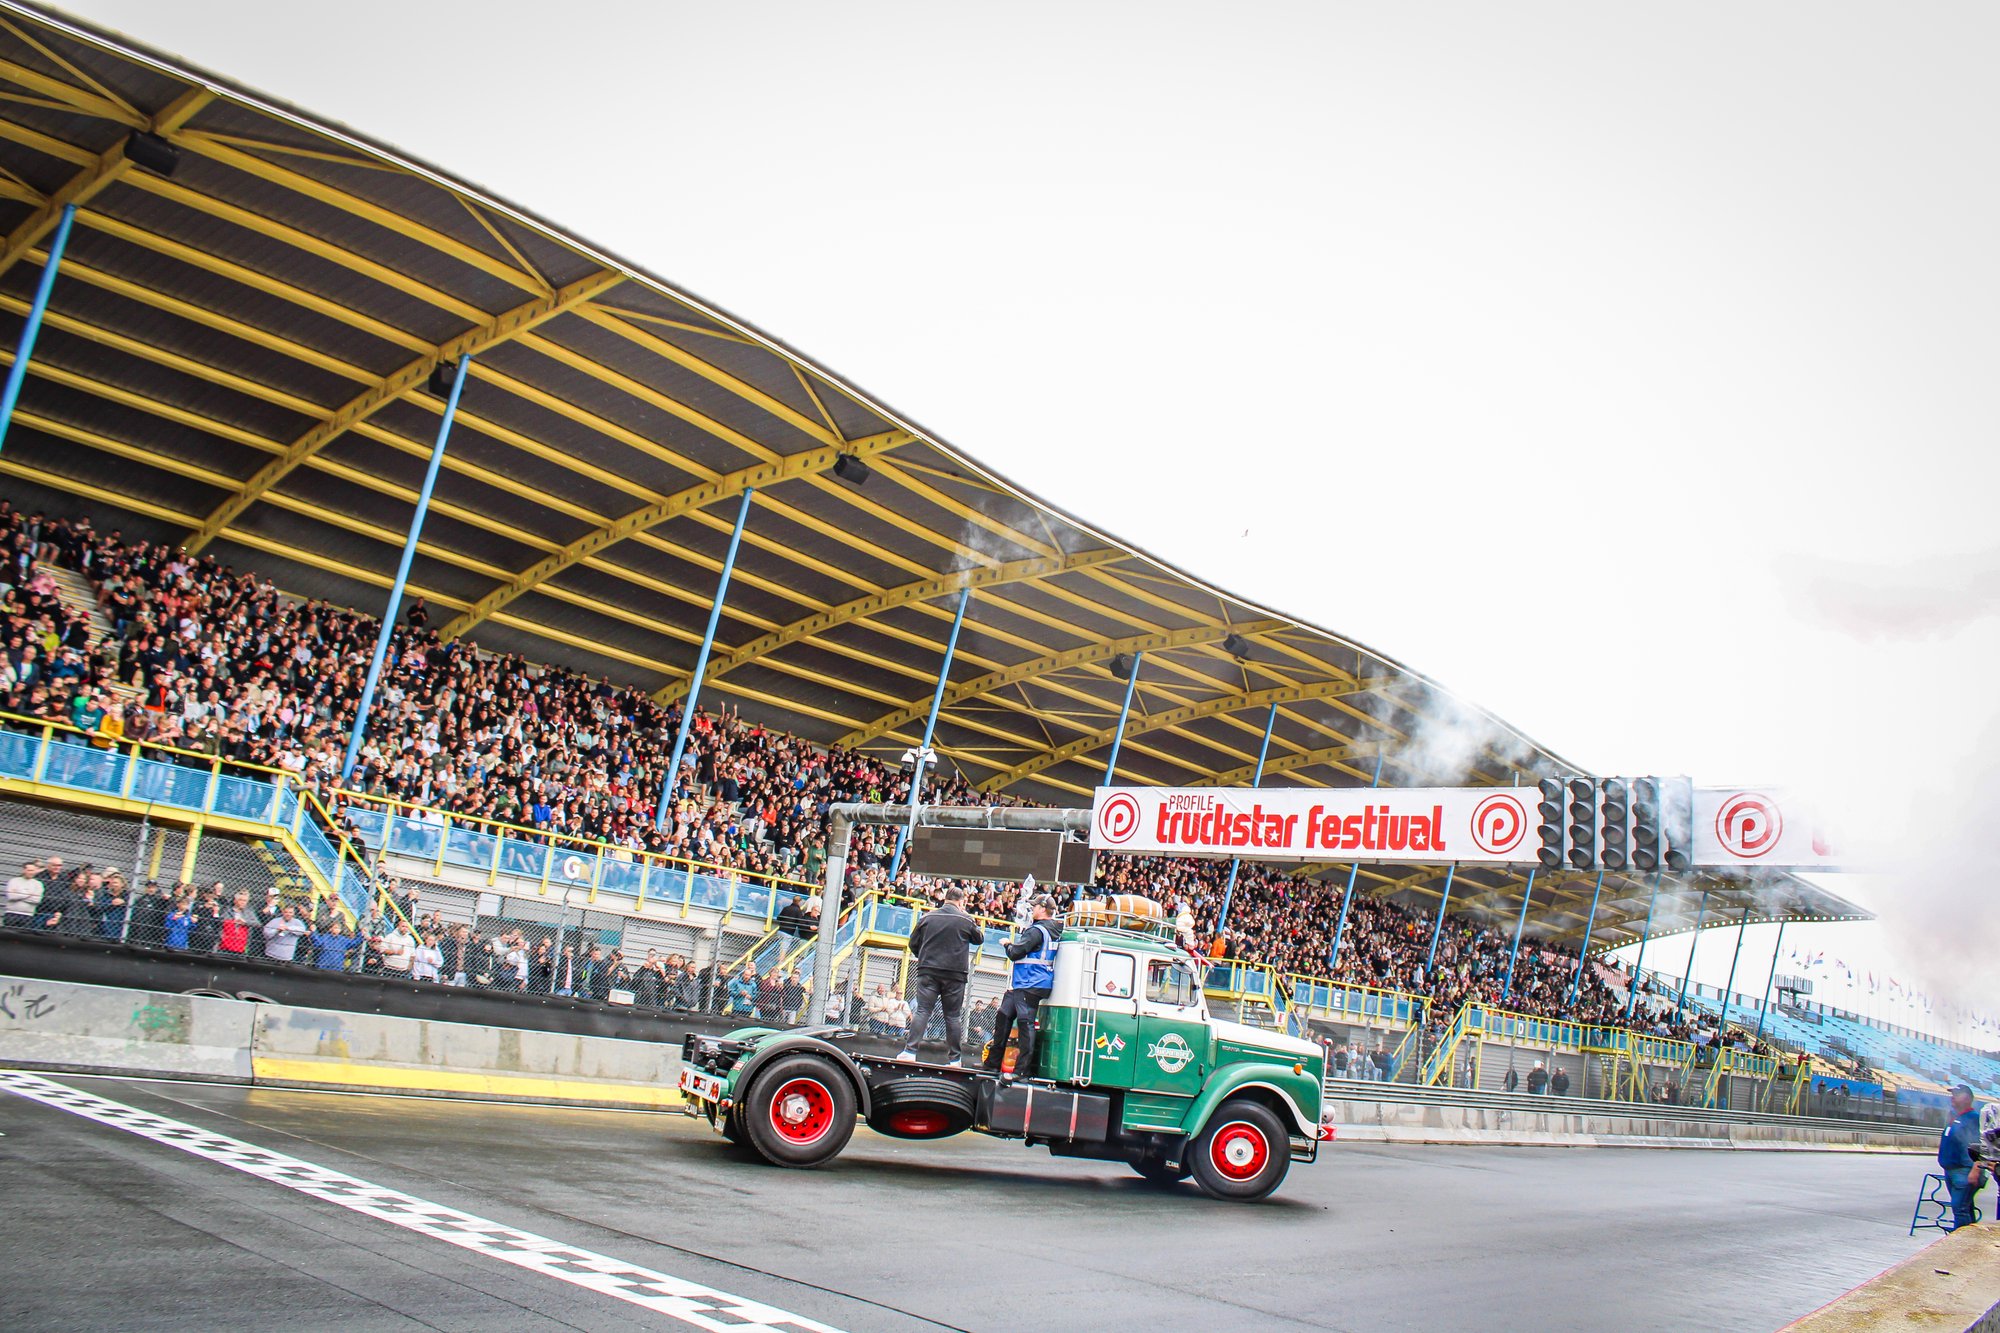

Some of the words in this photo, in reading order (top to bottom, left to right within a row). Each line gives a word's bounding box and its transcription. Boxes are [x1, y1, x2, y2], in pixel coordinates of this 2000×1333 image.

[1169, 795, 1214, 811] PROFILE
[1156, 803, 1299, 848] truckstar
[563, 856, 582, 880] G
[1333, 992, 1342, 1007] E
[1517, 1022, 1525, 1035] D
